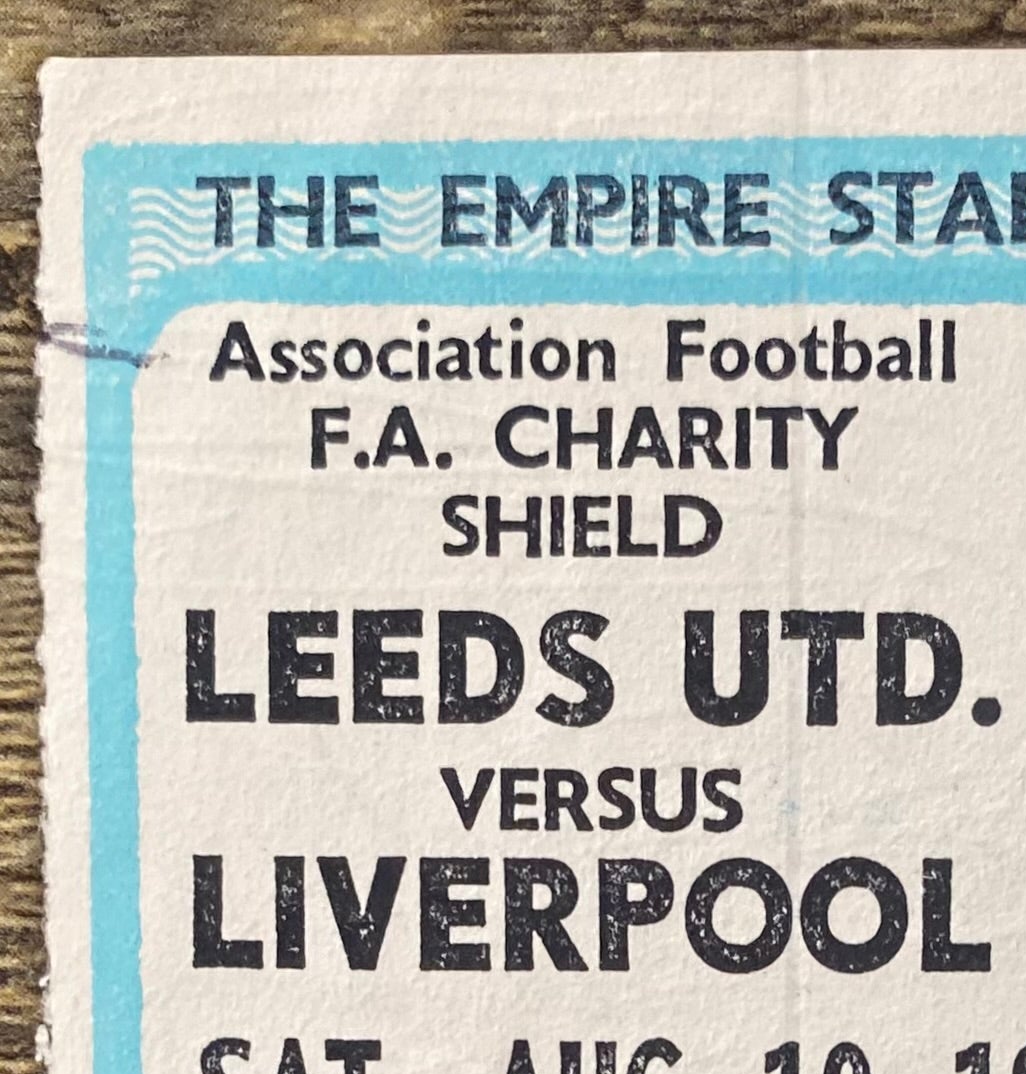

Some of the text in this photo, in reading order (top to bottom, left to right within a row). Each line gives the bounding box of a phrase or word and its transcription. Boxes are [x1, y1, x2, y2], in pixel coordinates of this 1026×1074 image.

[197, 176, 379, 247] THE
[442, 174, 770, 246] EMPIRE
[210, 318, 955, 382] Association Football
[311, 405, 858, 469] F.A. CHARITY
[443, 495, 722, 557] SHIELD
[186, 609, 1001, 727] LEEDS UTD.
[440, 767, 742, 833] VERSUS
[193, 855, 991, 974] LIVERPOOL
